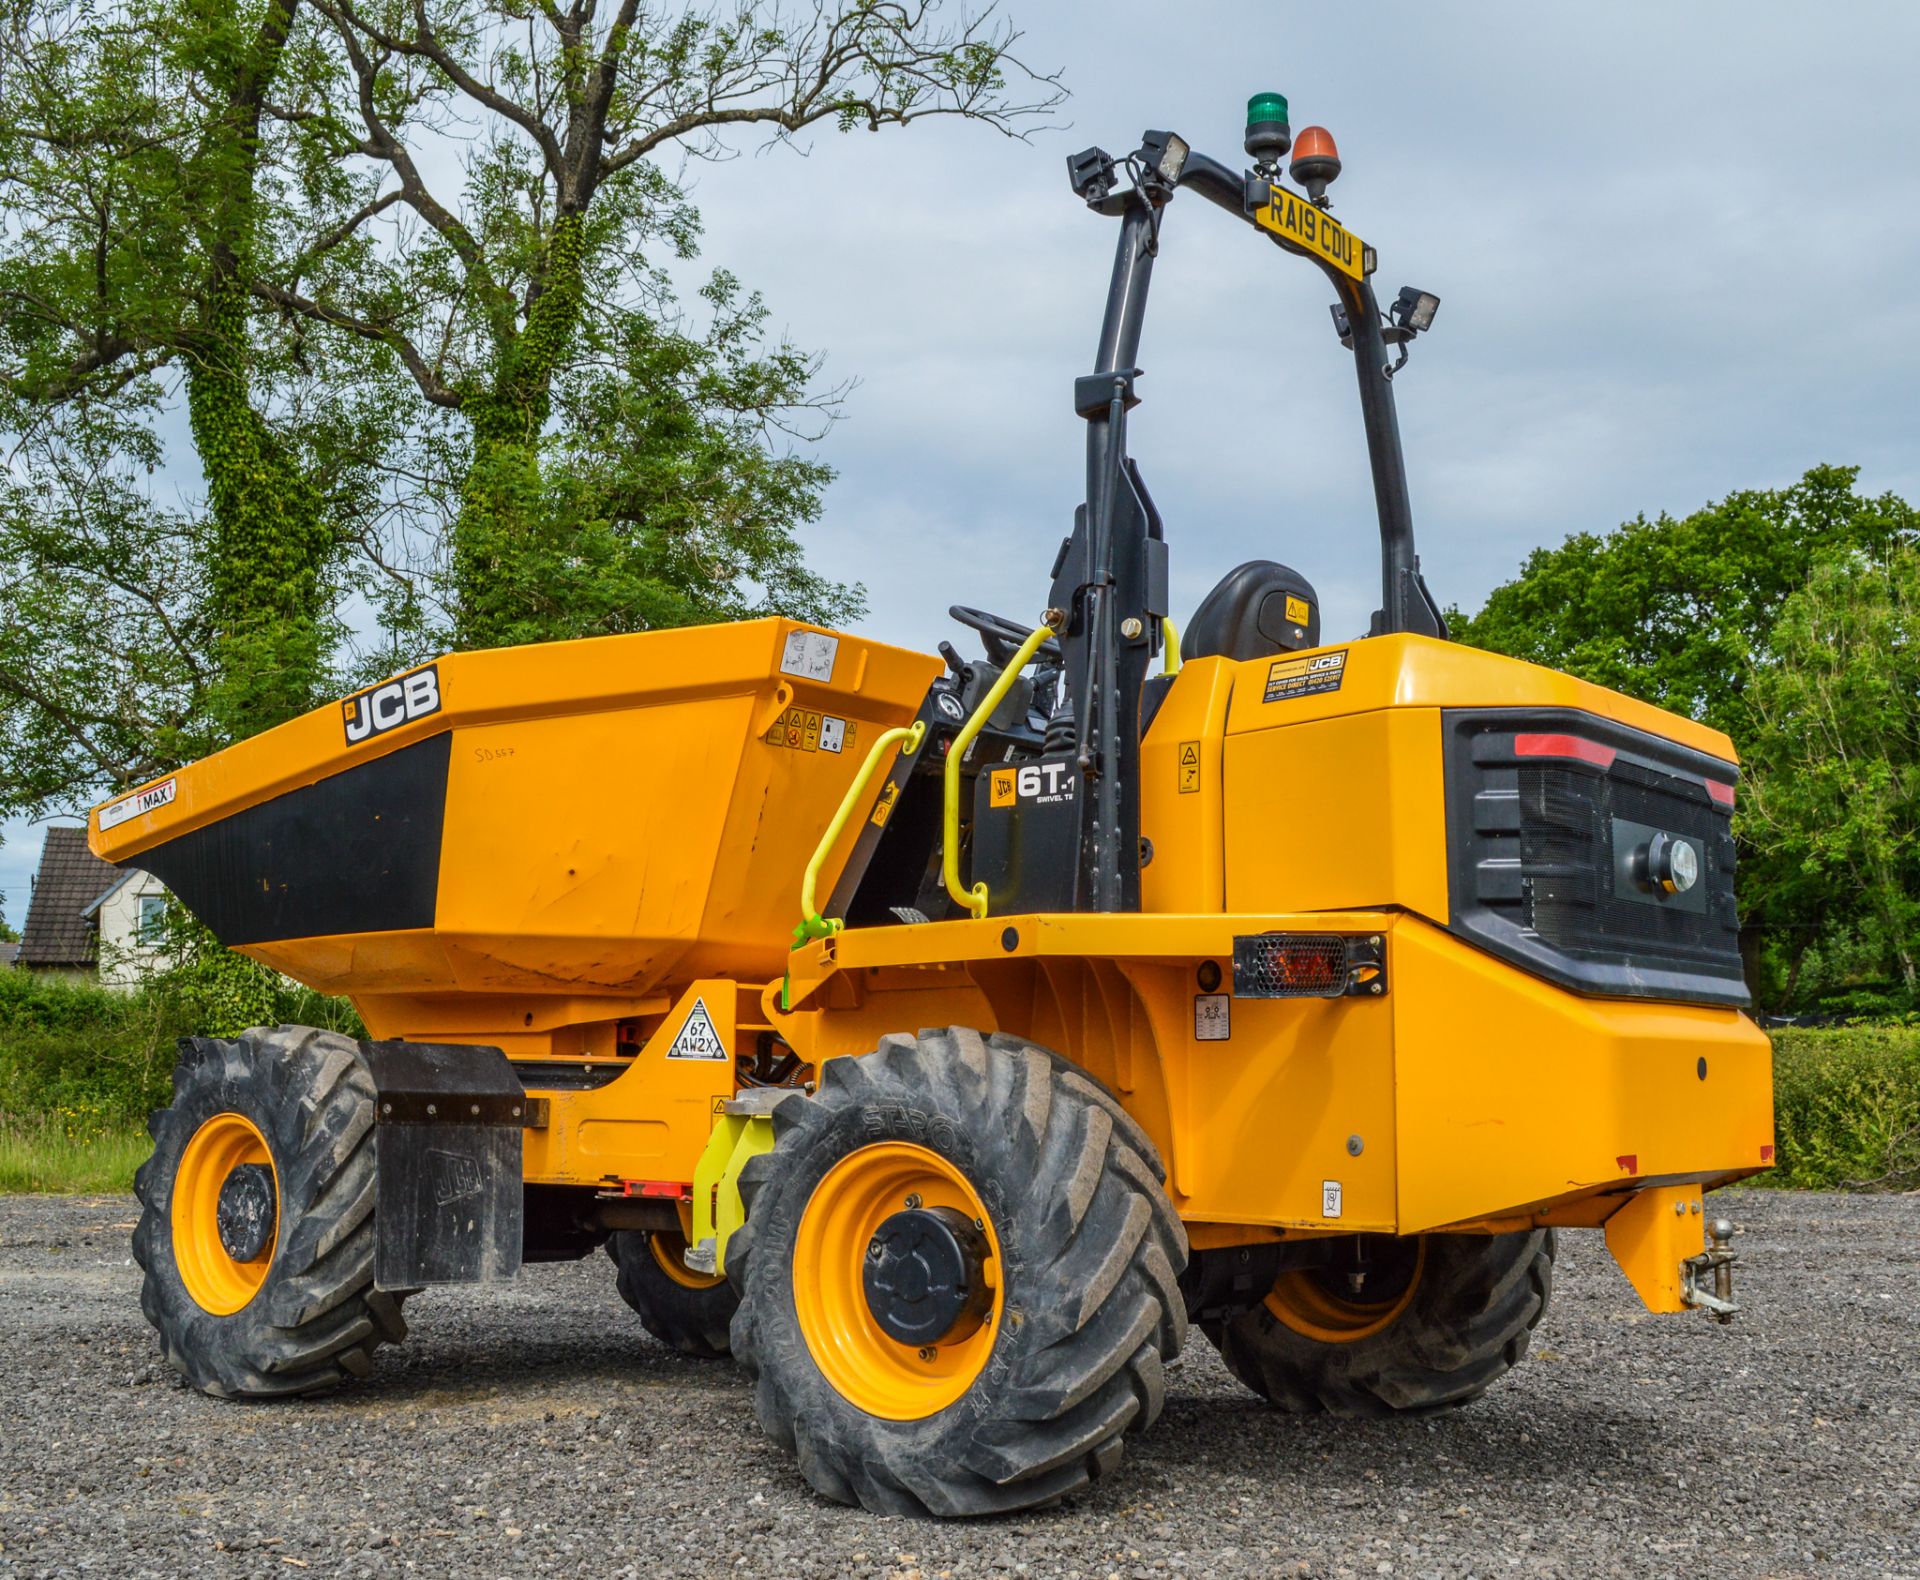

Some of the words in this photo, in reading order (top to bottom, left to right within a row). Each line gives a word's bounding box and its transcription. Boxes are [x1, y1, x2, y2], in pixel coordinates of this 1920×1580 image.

[1270, 189, 1316, 243] RA19
[1321, 217, 1352, 267] CDU
[1310, 655, 1342, 671] JCB
[346, 670, 439, 741] JCB
[997, 780, 1012, 796] JCB
[143, 788, 168, 810] MAX
[1036, 794, 1063, 804] SWIVEL
[690, 1022, 706, 1036] 67
[680, 1037, 714, 1053] AW2X
